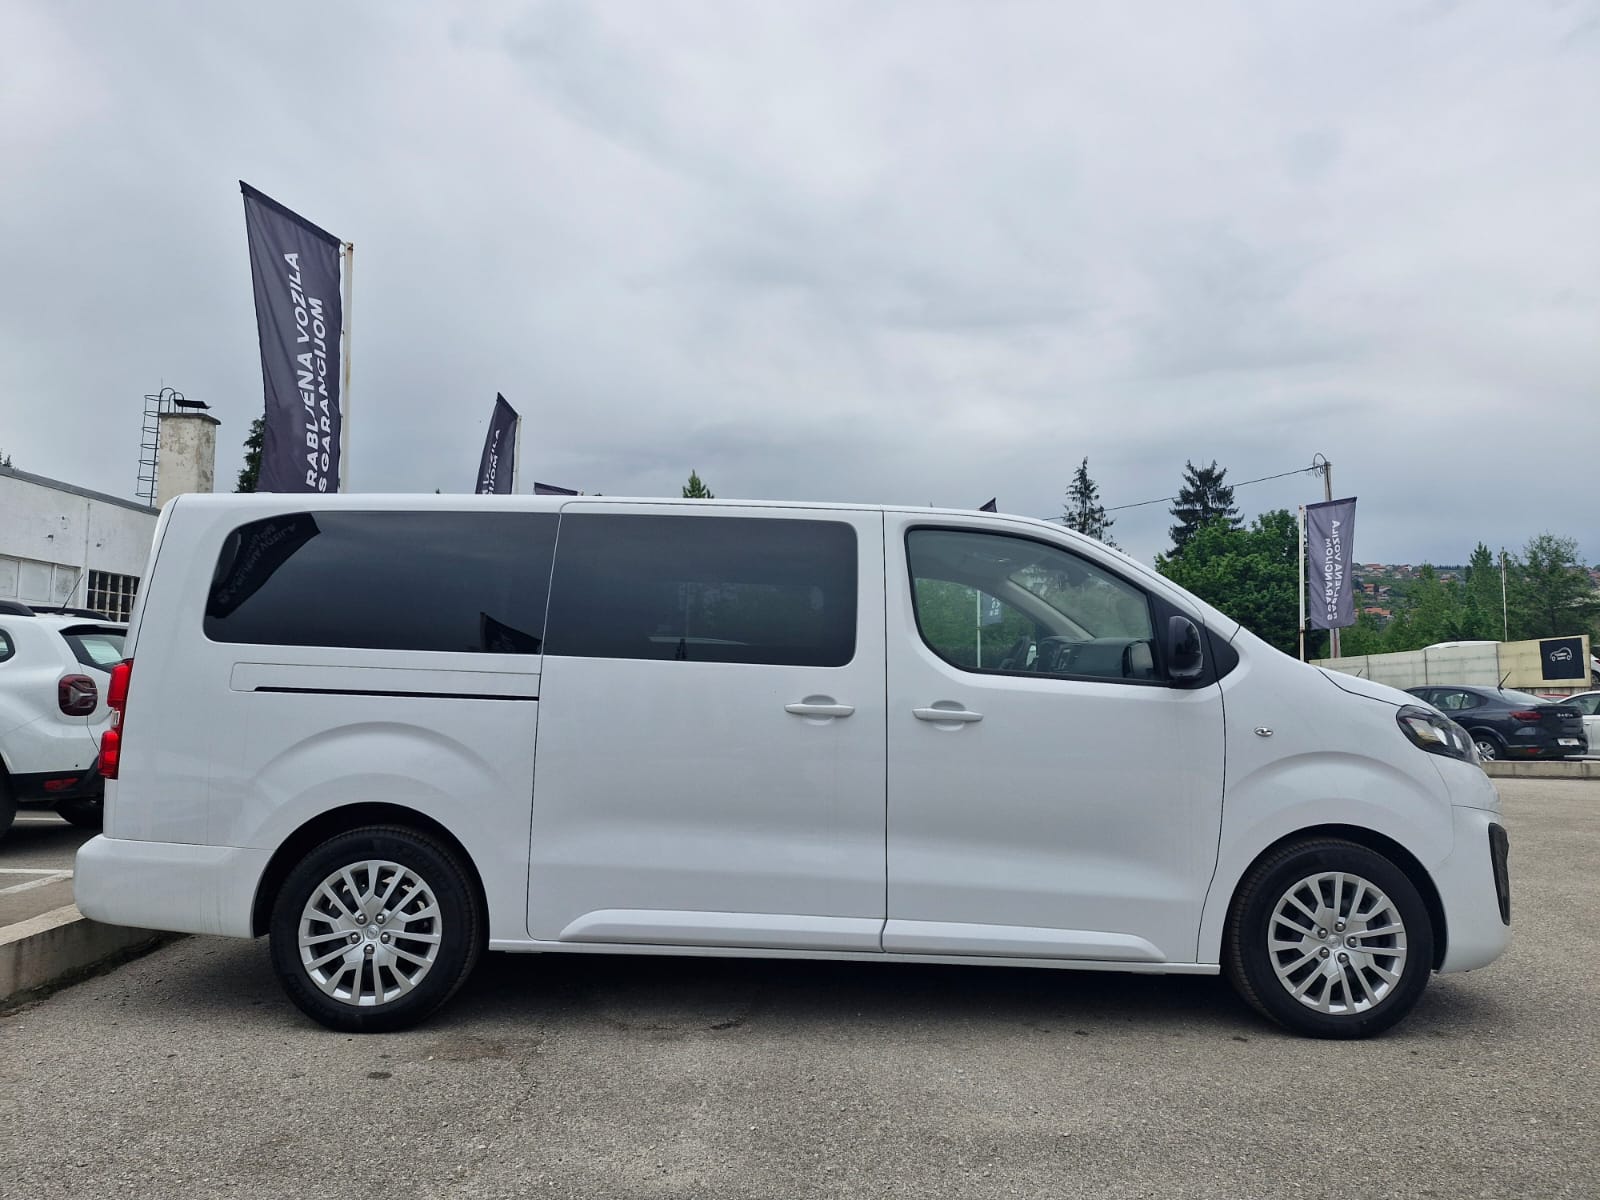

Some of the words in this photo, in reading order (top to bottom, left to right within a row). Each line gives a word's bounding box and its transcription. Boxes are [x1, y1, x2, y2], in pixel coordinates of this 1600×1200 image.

[284, 252, 309, 343] VOZILA
[296, 352, 319, 488] RABLJENA
[308, 297, 331, 472] GARANCIJOM
[318, 477, 327, 494] S
